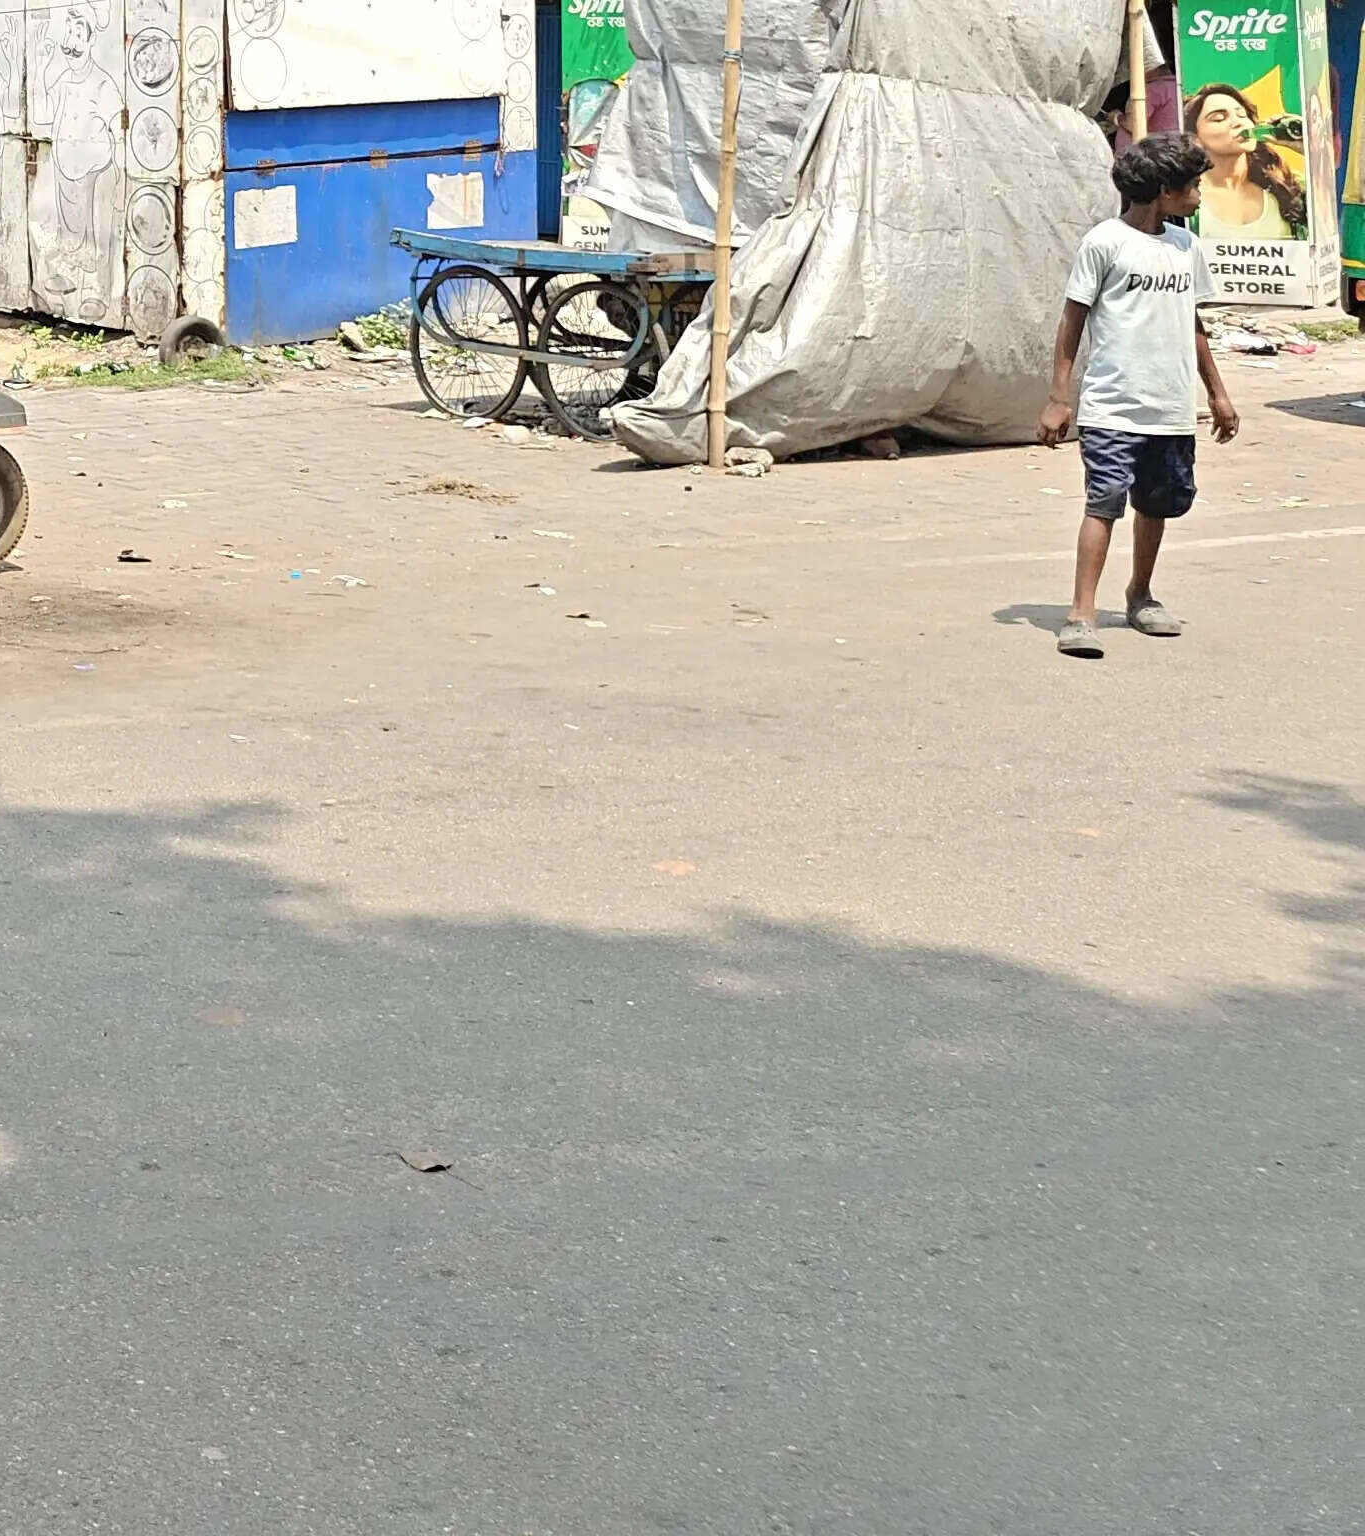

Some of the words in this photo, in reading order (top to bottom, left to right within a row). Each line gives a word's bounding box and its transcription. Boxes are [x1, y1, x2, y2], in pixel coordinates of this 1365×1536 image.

[1188, 7, 1288, 41] Sprite
[1213, 35, 1238, 51] ठंड
[1240, 38, 1268, 51] रख
[1215, 244, 1284, 258] SUMAN
[1209, 263, 1297, 277] GENERAL
[1126, 271, 1191, 294] DONALD
[1223, 281, 1286, 295] STORE
